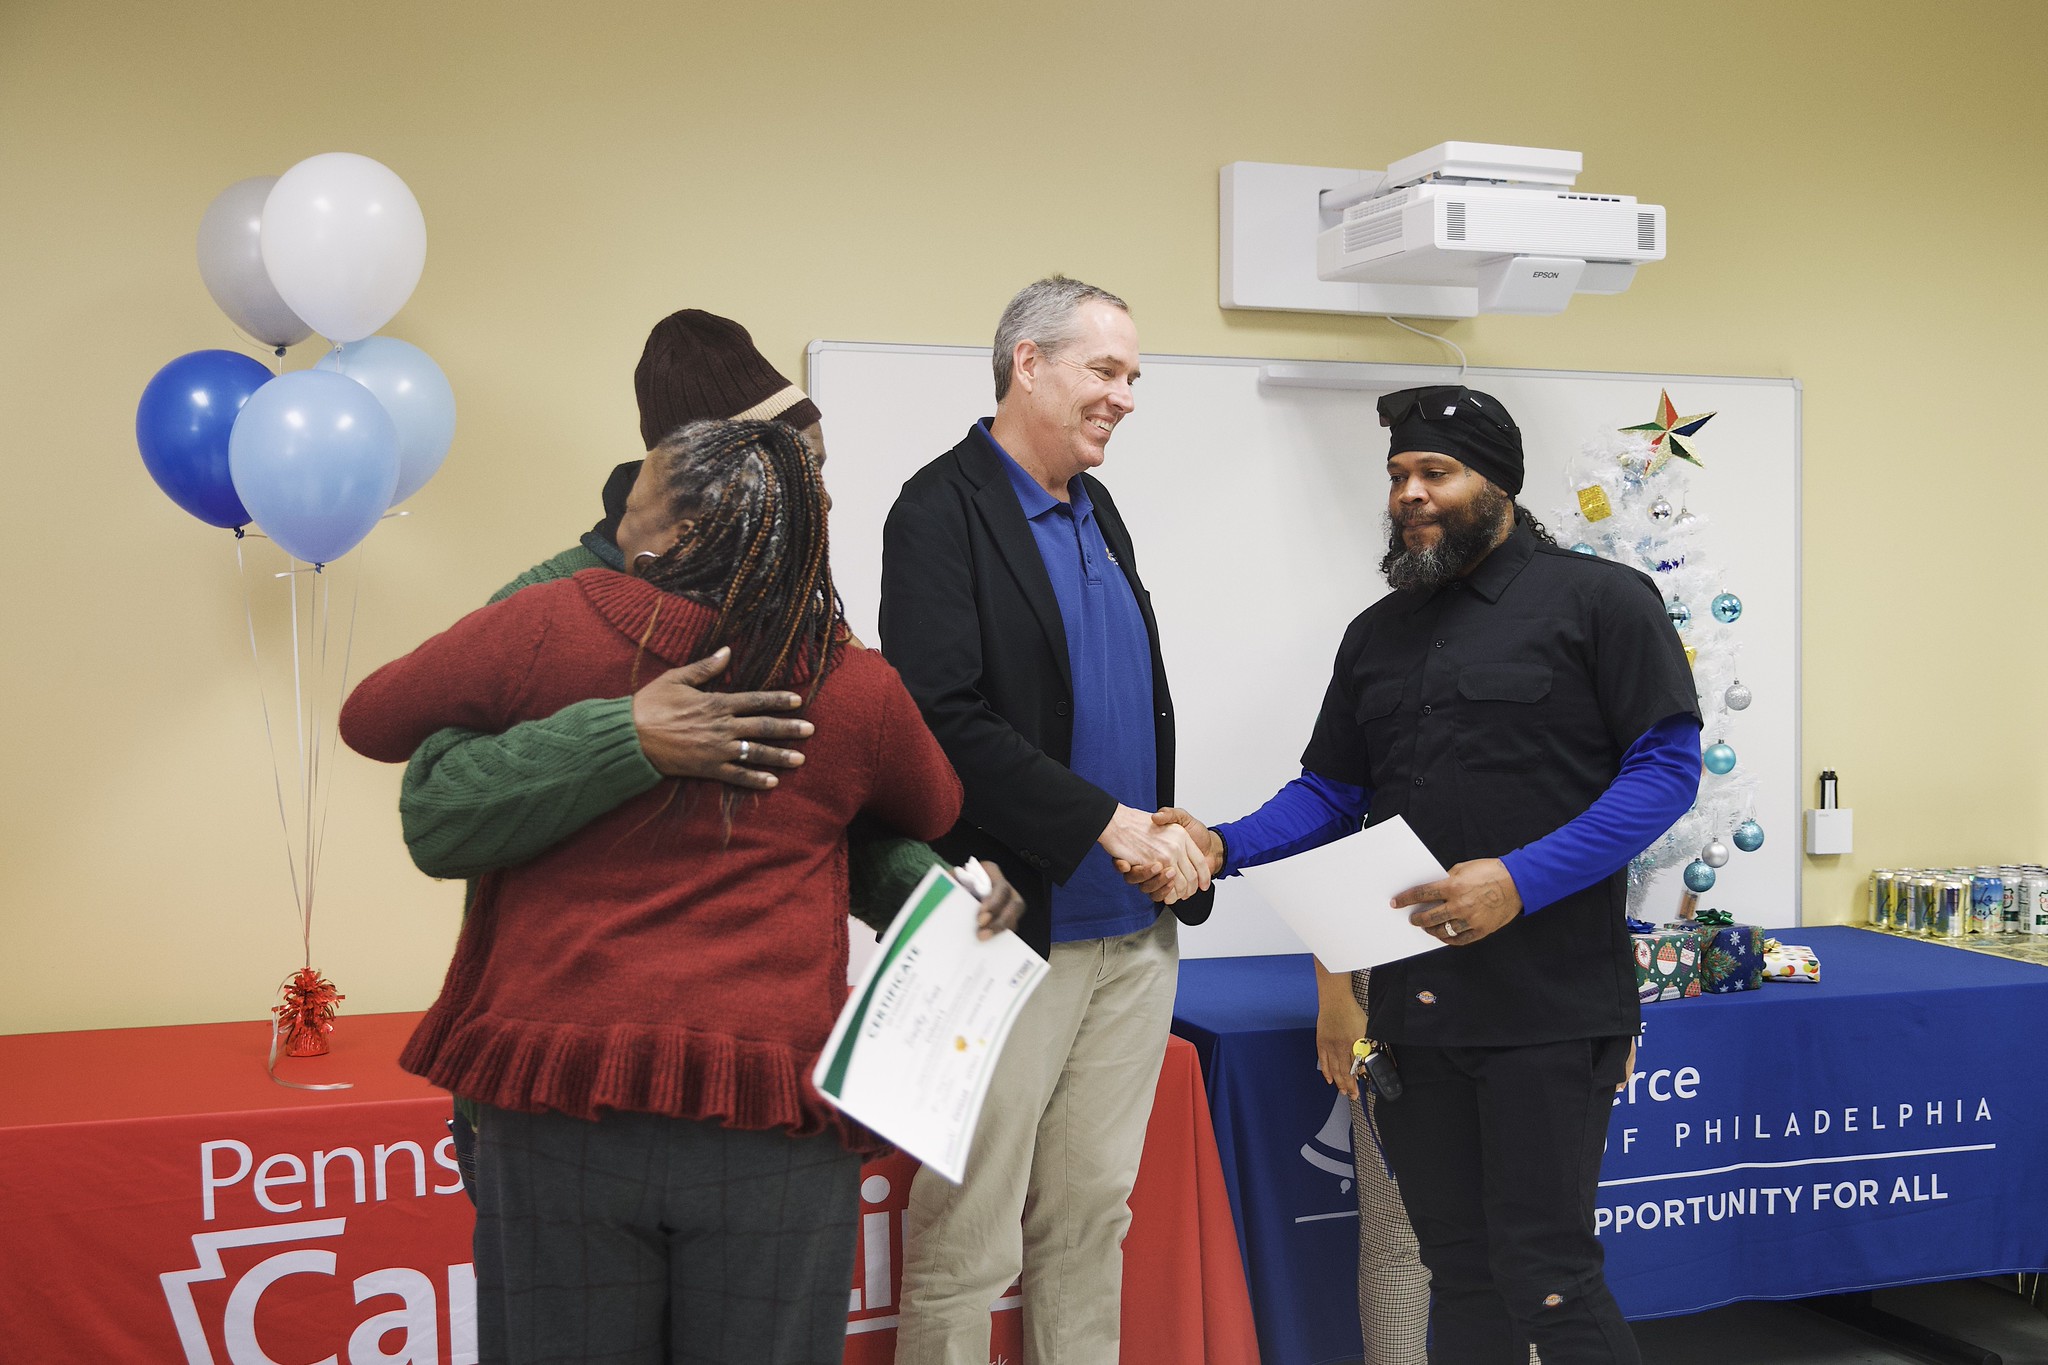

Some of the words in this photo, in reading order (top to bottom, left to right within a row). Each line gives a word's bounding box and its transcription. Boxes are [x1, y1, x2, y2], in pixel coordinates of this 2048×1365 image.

[1532, 271, 1560, 279] EPSON
[866, 947, 921, 1038] CERTIFICATE
[1603, 1127, 1639, 1154] F
[1675, 1097, 1992, 1148] PHILADELPHIA
[200, 1135, 465, 1221] Penns
[1593, 1185, 1803, 1236] PPORTUNITY
[1813, 1179, 1879, 1211] FOR
[1888, 1173, 1949, 1204] ALL
